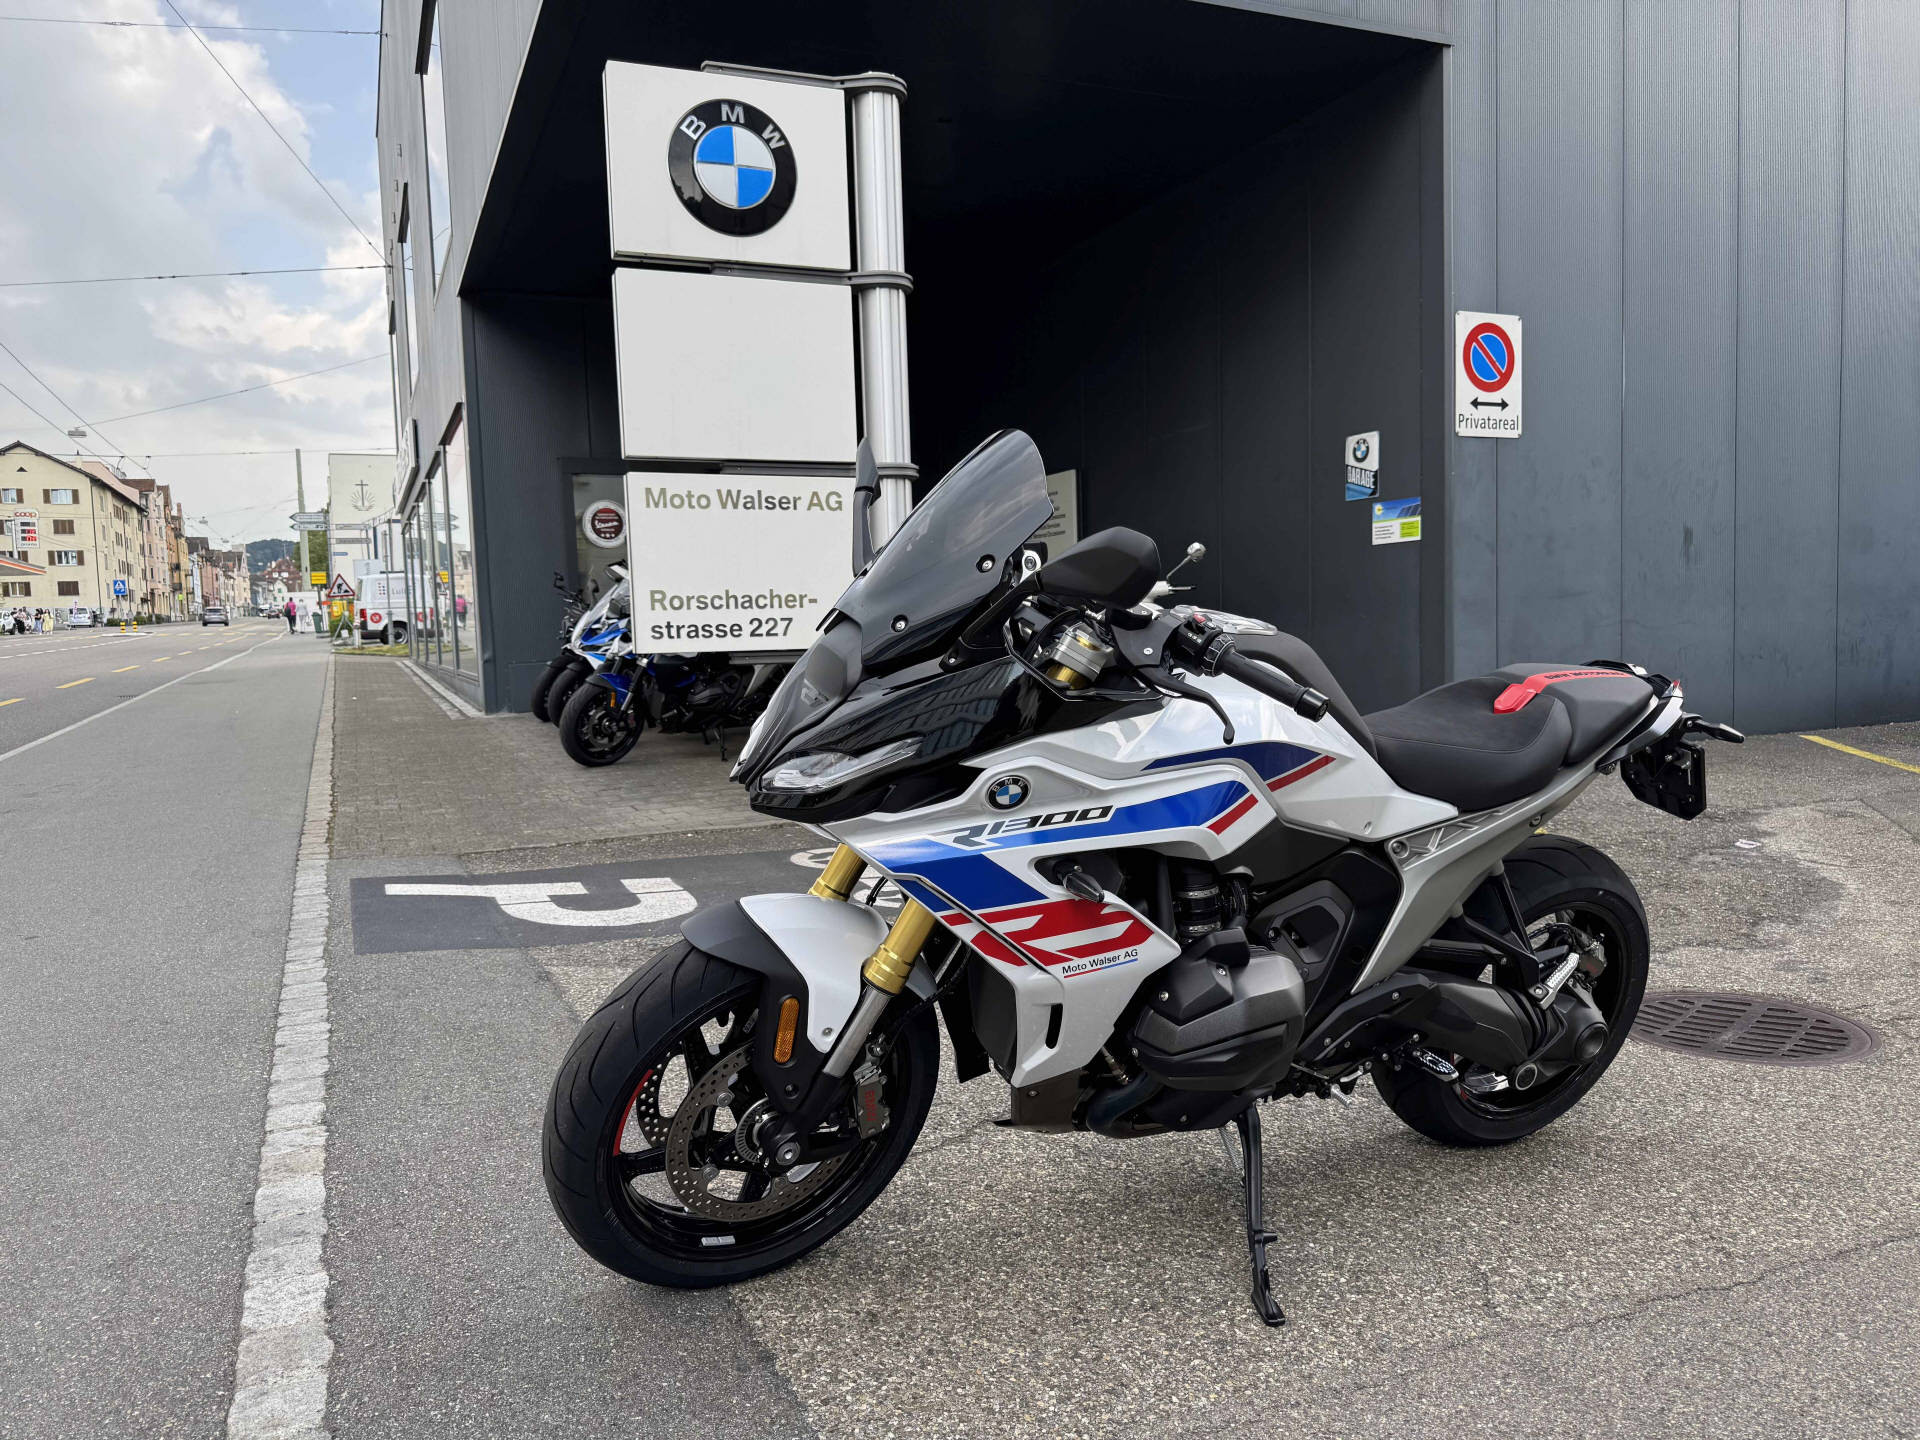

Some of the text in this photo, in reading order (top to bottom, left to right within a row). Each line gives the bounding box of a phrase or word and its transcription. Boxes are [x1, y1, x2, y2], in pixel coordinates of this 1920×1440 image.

[680, 102, 786, 149] BMW
[1458, 413, 1519, 431] Privatareal
[1347, 466, 1376, 488] GARAGE
[645, 487, 844, 512] Moto Walser AG
[649, 588, 819, 611] Rorschacher-
[651, 617, 794, 640] strasse 227
[992, 779, 1026, 792] BMW
[1062, 948, 1139, 975] Moto Walser AG
